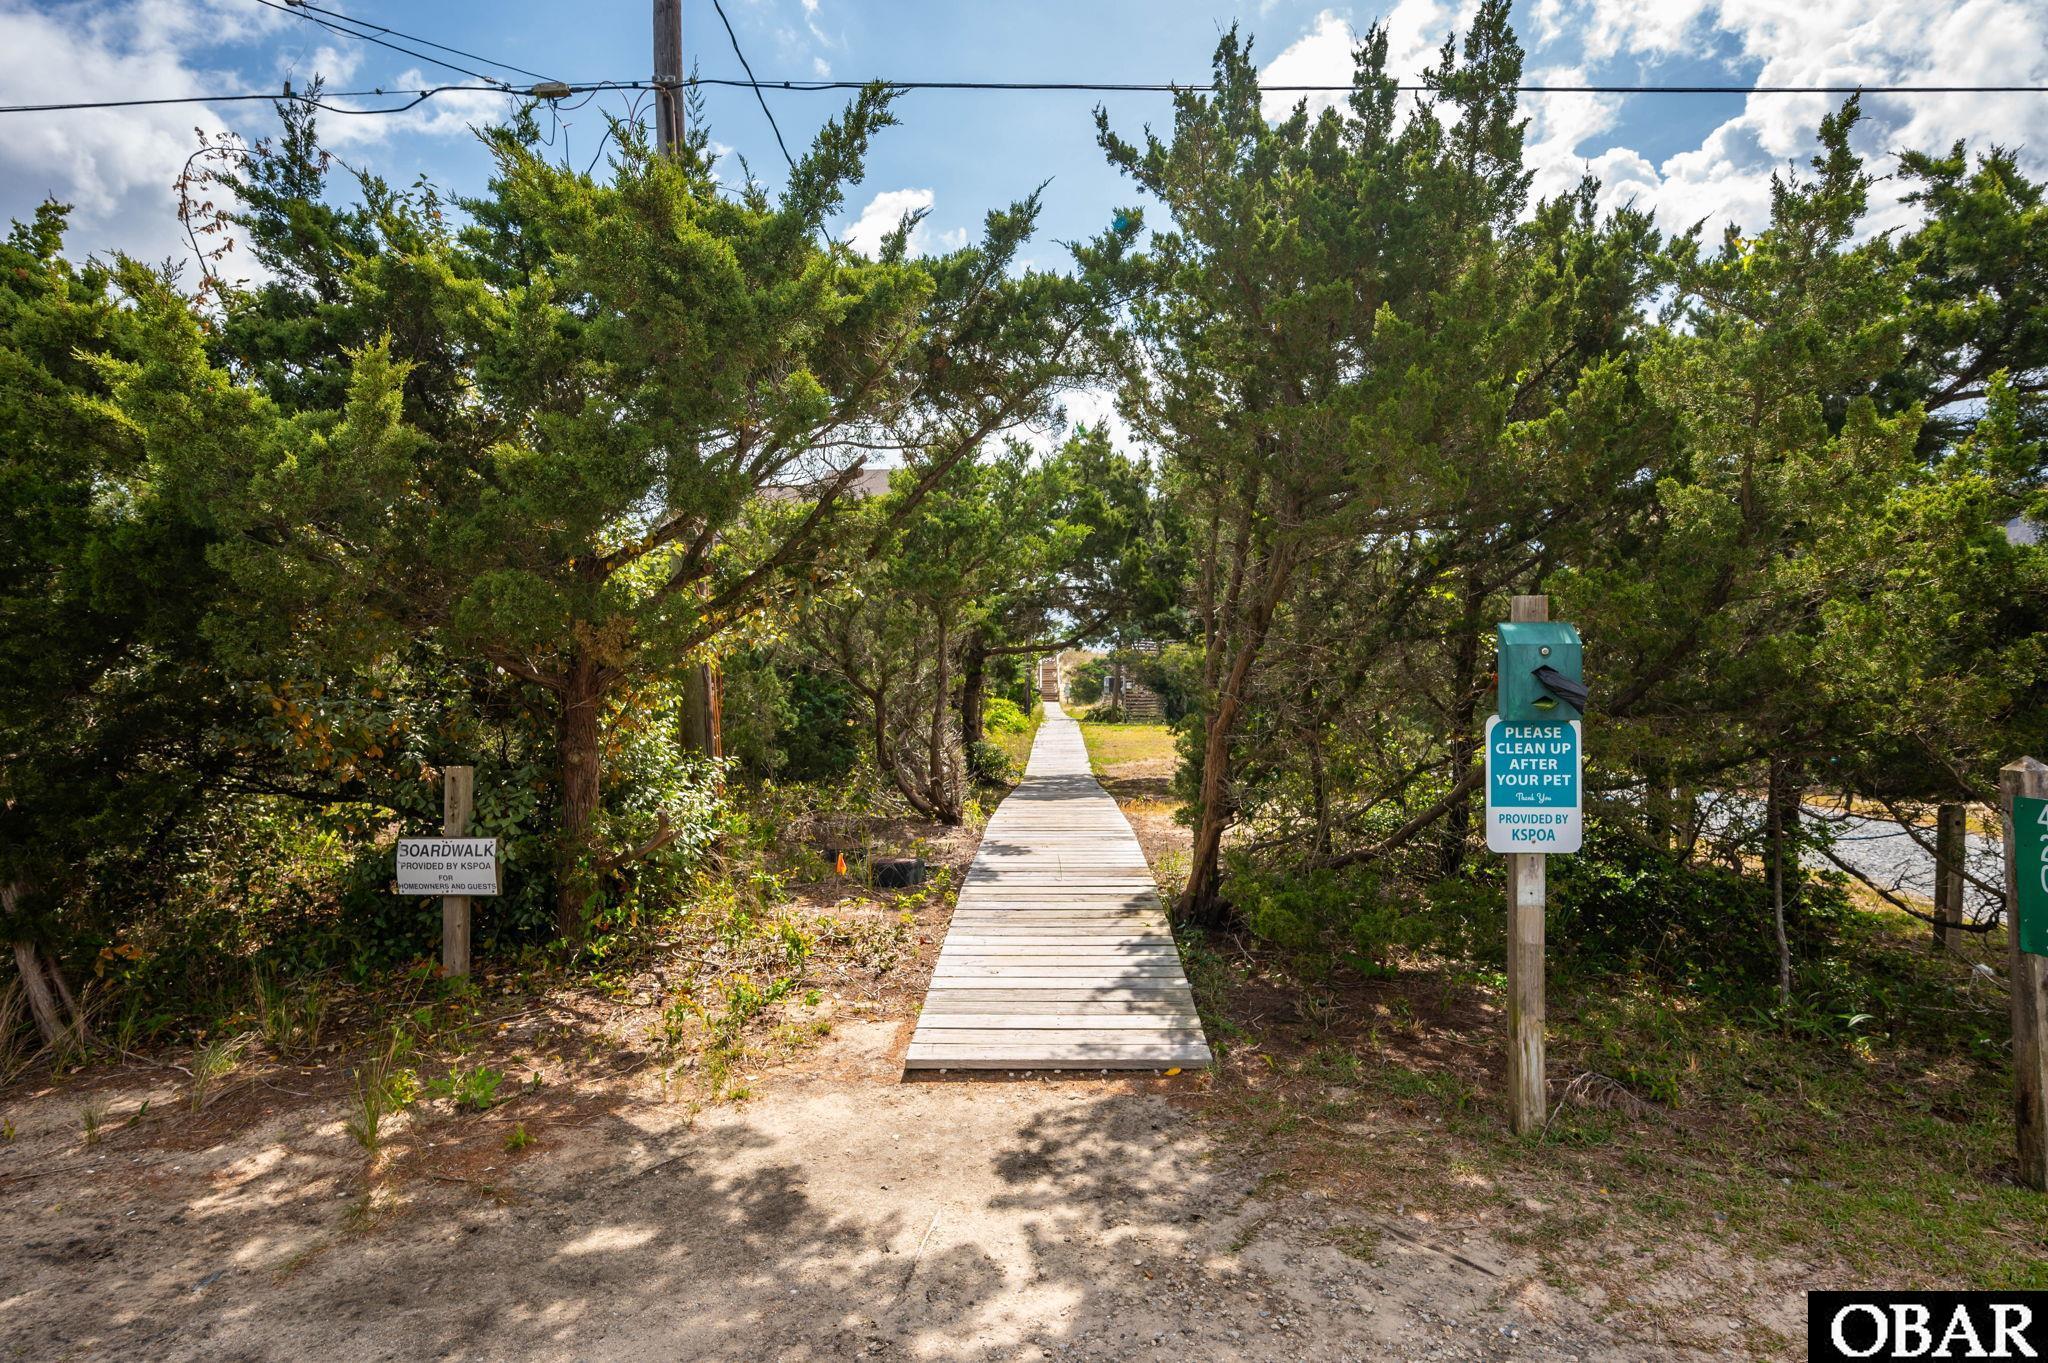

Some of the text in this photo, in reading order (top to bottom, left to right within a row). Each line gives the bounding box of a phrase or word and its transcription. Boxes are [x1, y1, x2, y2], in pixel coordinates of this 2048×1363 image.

[1505, 727, 1562, 739] PLEASE
[1495, 743, 1571, 755] CLEAN UP
[1509, 758, 1558, 770] AFTER
[1496, 774, 1572, 786] YOUR PET
[1515, 792, 1552, 804] Thank You
[1498, 813, 1569, 825] PROVIDED BY
[1512, 829, 1556, 841] KSPOA
[399, 844, 494, 857] BOARDWALK
[400, 862, 491, 870] PROVIDED BY KSPOA
